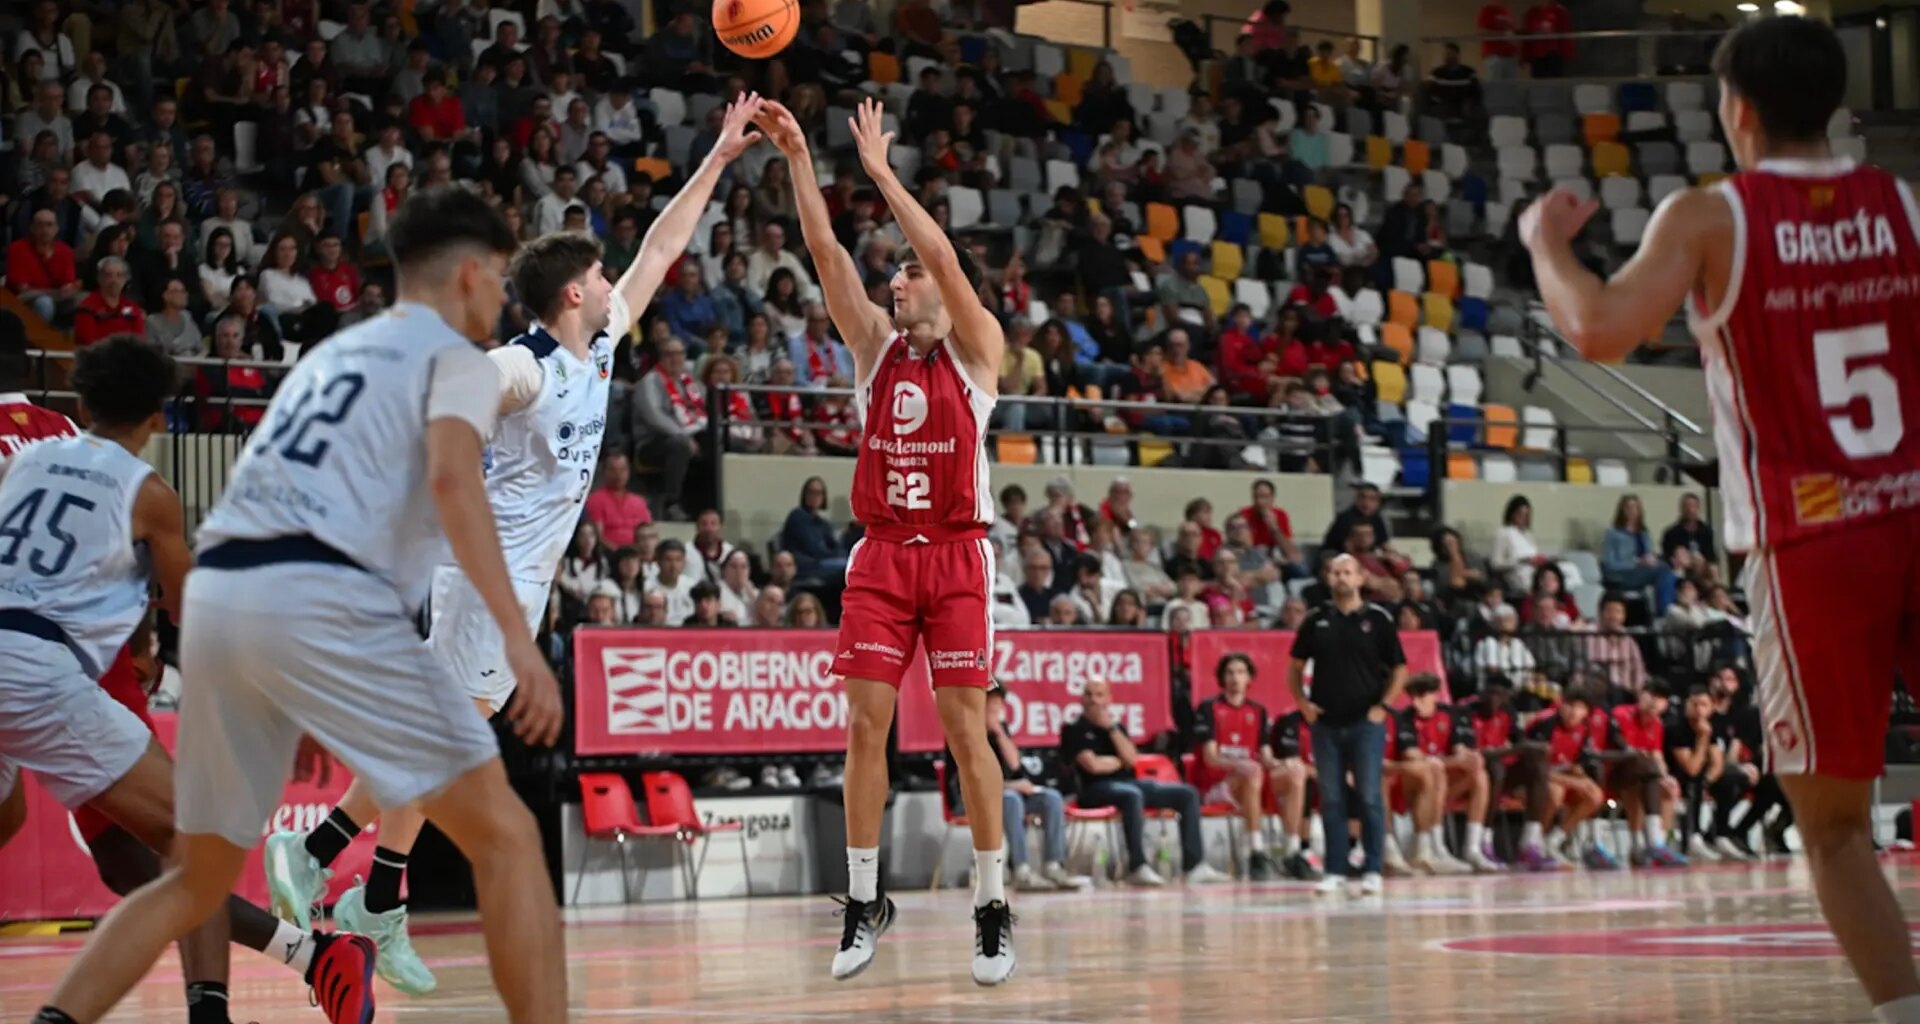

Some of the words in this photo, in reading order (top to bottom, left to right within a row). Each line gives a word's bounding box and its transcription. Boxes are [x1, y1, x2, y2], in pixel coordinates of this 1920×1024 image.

[1774, 207, 1898, 264] GARCÍA
[1813, 322, 1904, 459] 5
[886, 469, 932, 510] 22
[0, 487, 97, 577] 45
[667, 650, 837, 691] GOBIERNO
[995, 639, 1144, 696] Zaragoza
[668, 691, 713, 732] DE
[1002, 691, 1146, 737] DEPOTE
